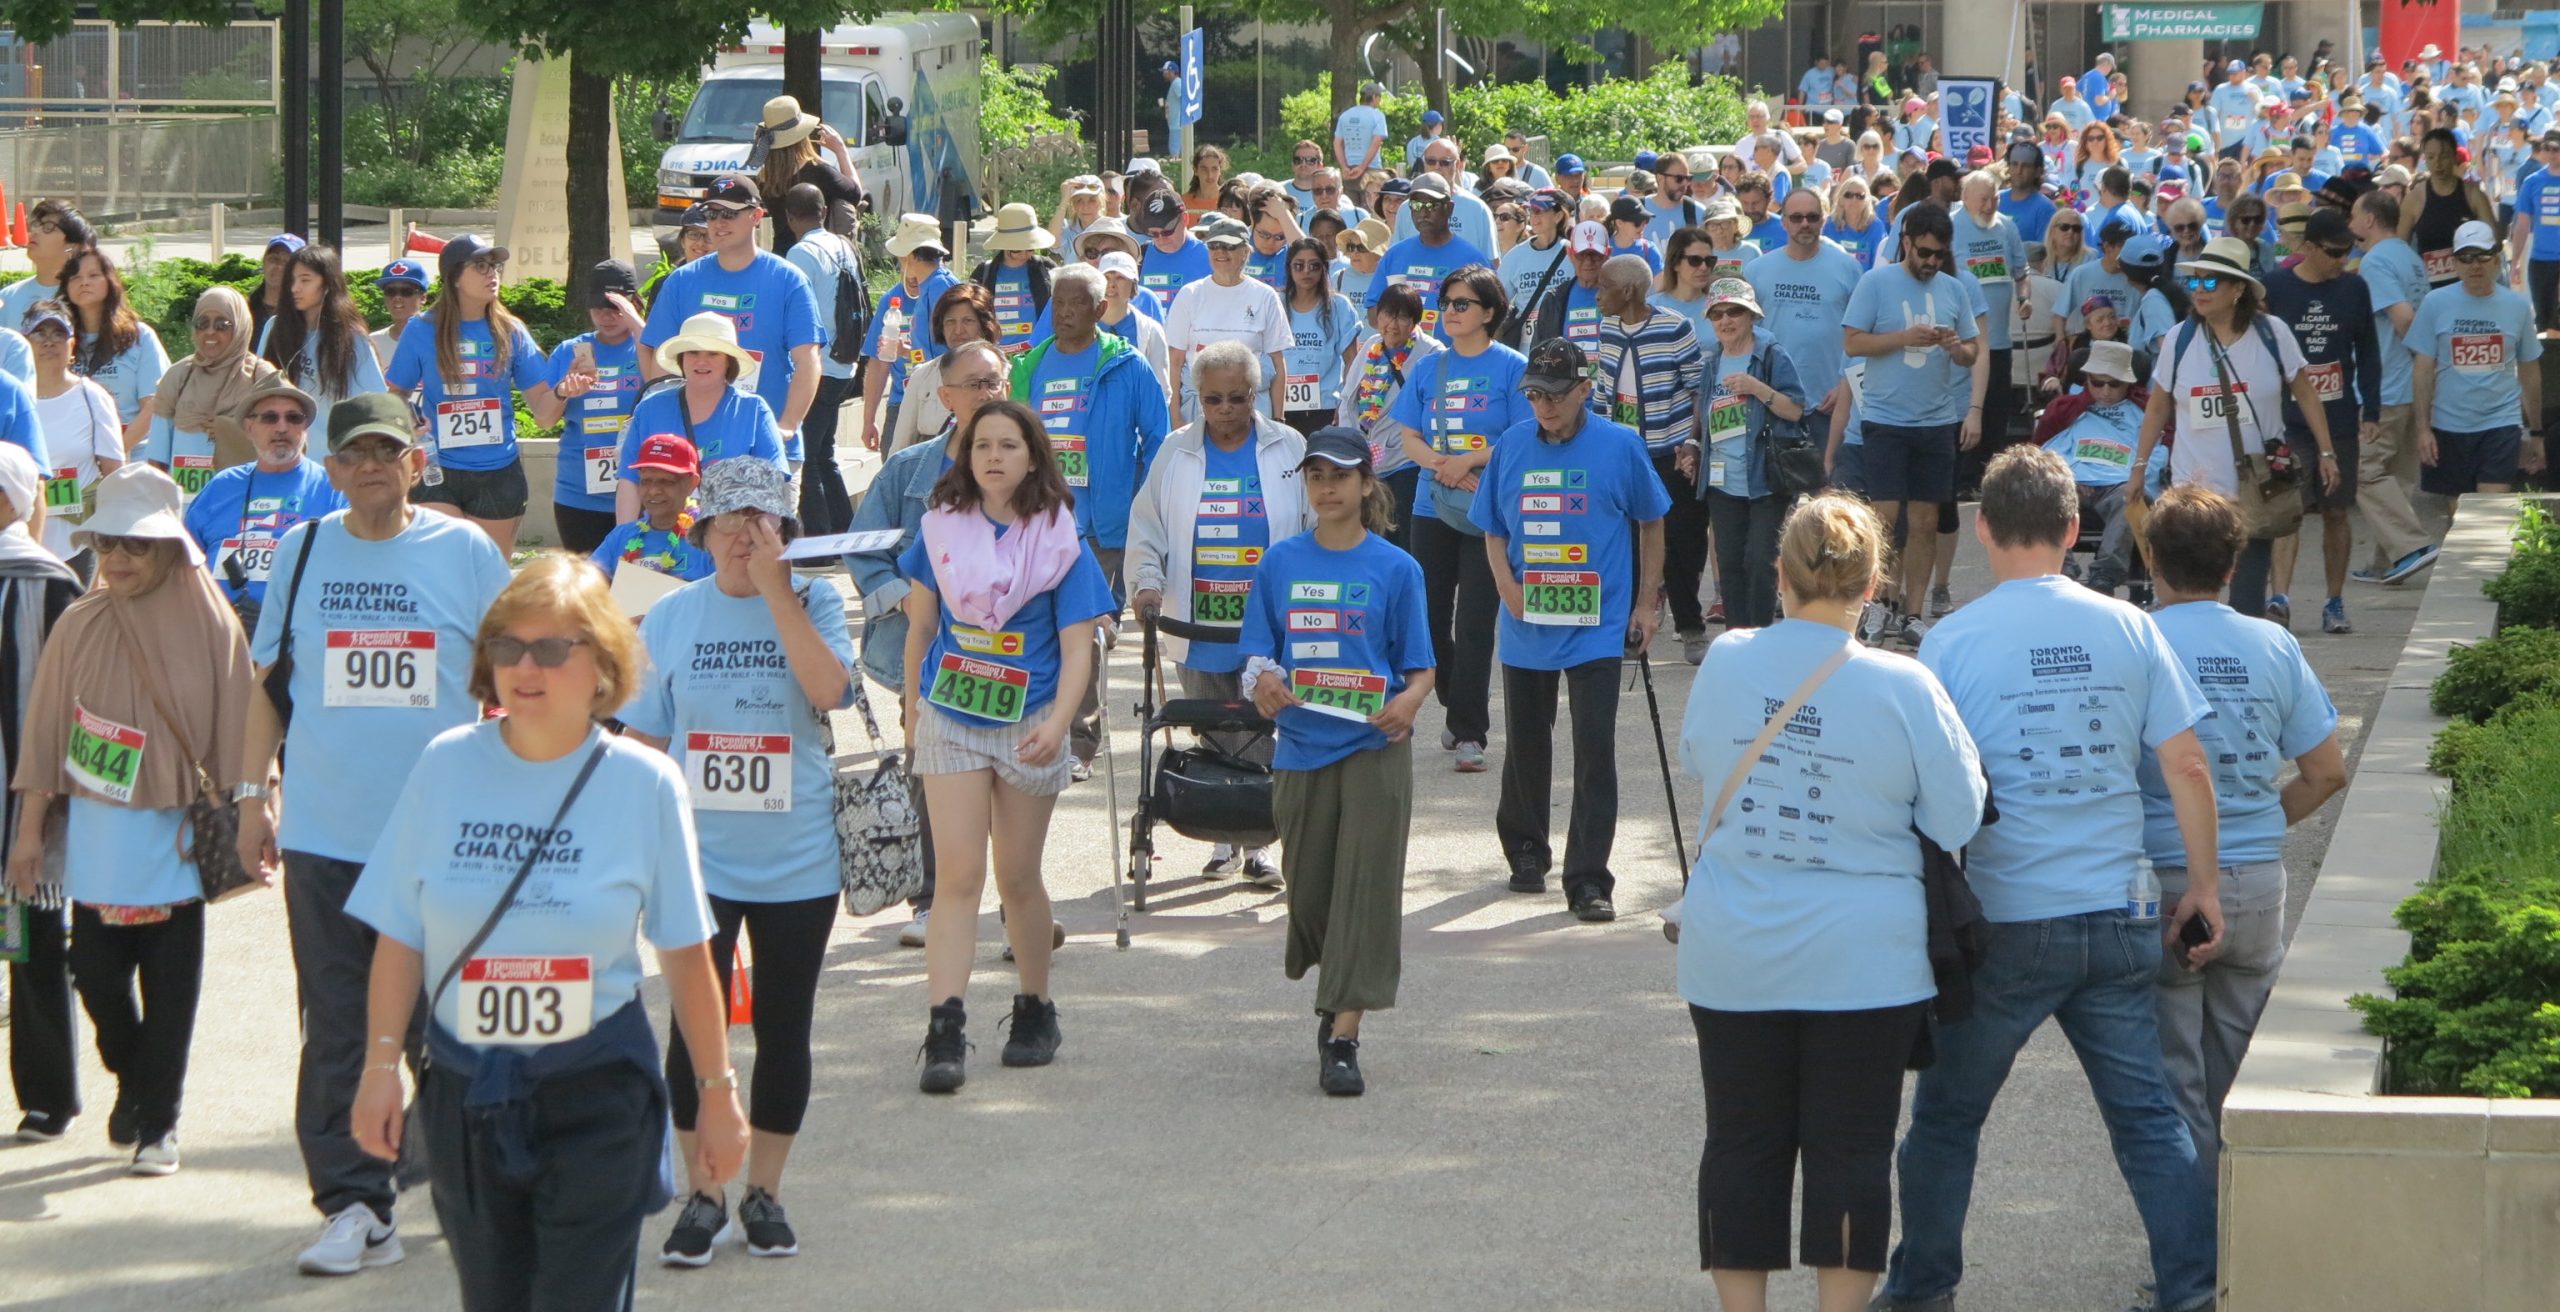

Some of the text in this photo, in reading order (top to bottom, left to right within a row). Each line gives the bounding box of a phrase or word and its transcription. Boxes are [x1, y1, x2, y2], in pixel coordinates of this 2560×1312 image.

[2134, 9, 2218, 21] MEDICAL
[2135, 24, 2256, 35] PHARMACIES
[1949, 131, 1985, 150] ESS
[1520, 269, 1565, 282] TOROO
[1775, 283, 1816, 293] TORONTO
[711, 297, 727, 306] Yes
[1774, 291, 1821, 301] CHALLENGE
[1577, 326, 1588, 334] No
[2454, 344, 2502, 365] 5259
[1052, 382, 1067, 390] Yes
[2308, 372, 2341, 393] 228
[1051, 402, 1064, 410] No
[450, 412, 491, 436] 254
[2076, 444, 2127, 465] 4252
[1532, 475, 1550, 484] Yes
[47, 480, 76, 505] 11
[1208, 482, 1228, 491] Yes
[1210, 504, 1225, 513] No
[1533, 500, 1548, 509] No
[1214, 527, 1221, 536] ?
[1537, 524, 1543, 533] ?
[244, 549, 273, 571] 89
[1200, 553, 1218, 561] Wrong
[321, 582, 407, 597] TORONTO
[1302, 586, 1325, 597] Yes
[320, 596, 418, 613] CHALLENGE
[1527, 586, 1593, 614] 4333
[1197, 594, 1244, 621] 433
[1303, 615, 1322, 626] No
[1578, 616, 1597, 625] 4333
[694, 640, 777, 657] TORONTO
[1310, 645, 1318, 655] ?
[2030, 645, 2082, 657] TORONTO
[691, 654, 787, 671] CHALLENGE
[2030, 653, 2091, 666] CHALLENGE
[2196, 657, 2240, 665] TORONTO
[346, 650, 416, 689] 906
[2198, 665, 2248, 674] CHALLENGE
[410, 695, 430, 706] 906
[936, 672, 1016, 718] 4319
[2000, 690, 2034, 701] Supporting
[1764, 697, 1817, 715] TORTO
[71, 728, 132, 782] 4644
[703, 754, 770, 793] 630
[103, 783, 127, 799] 4644
[764, 799, 784, 810] 630
[460, 822, 573, 846] TORONTO
[477, 985, 563, 1037] 903
